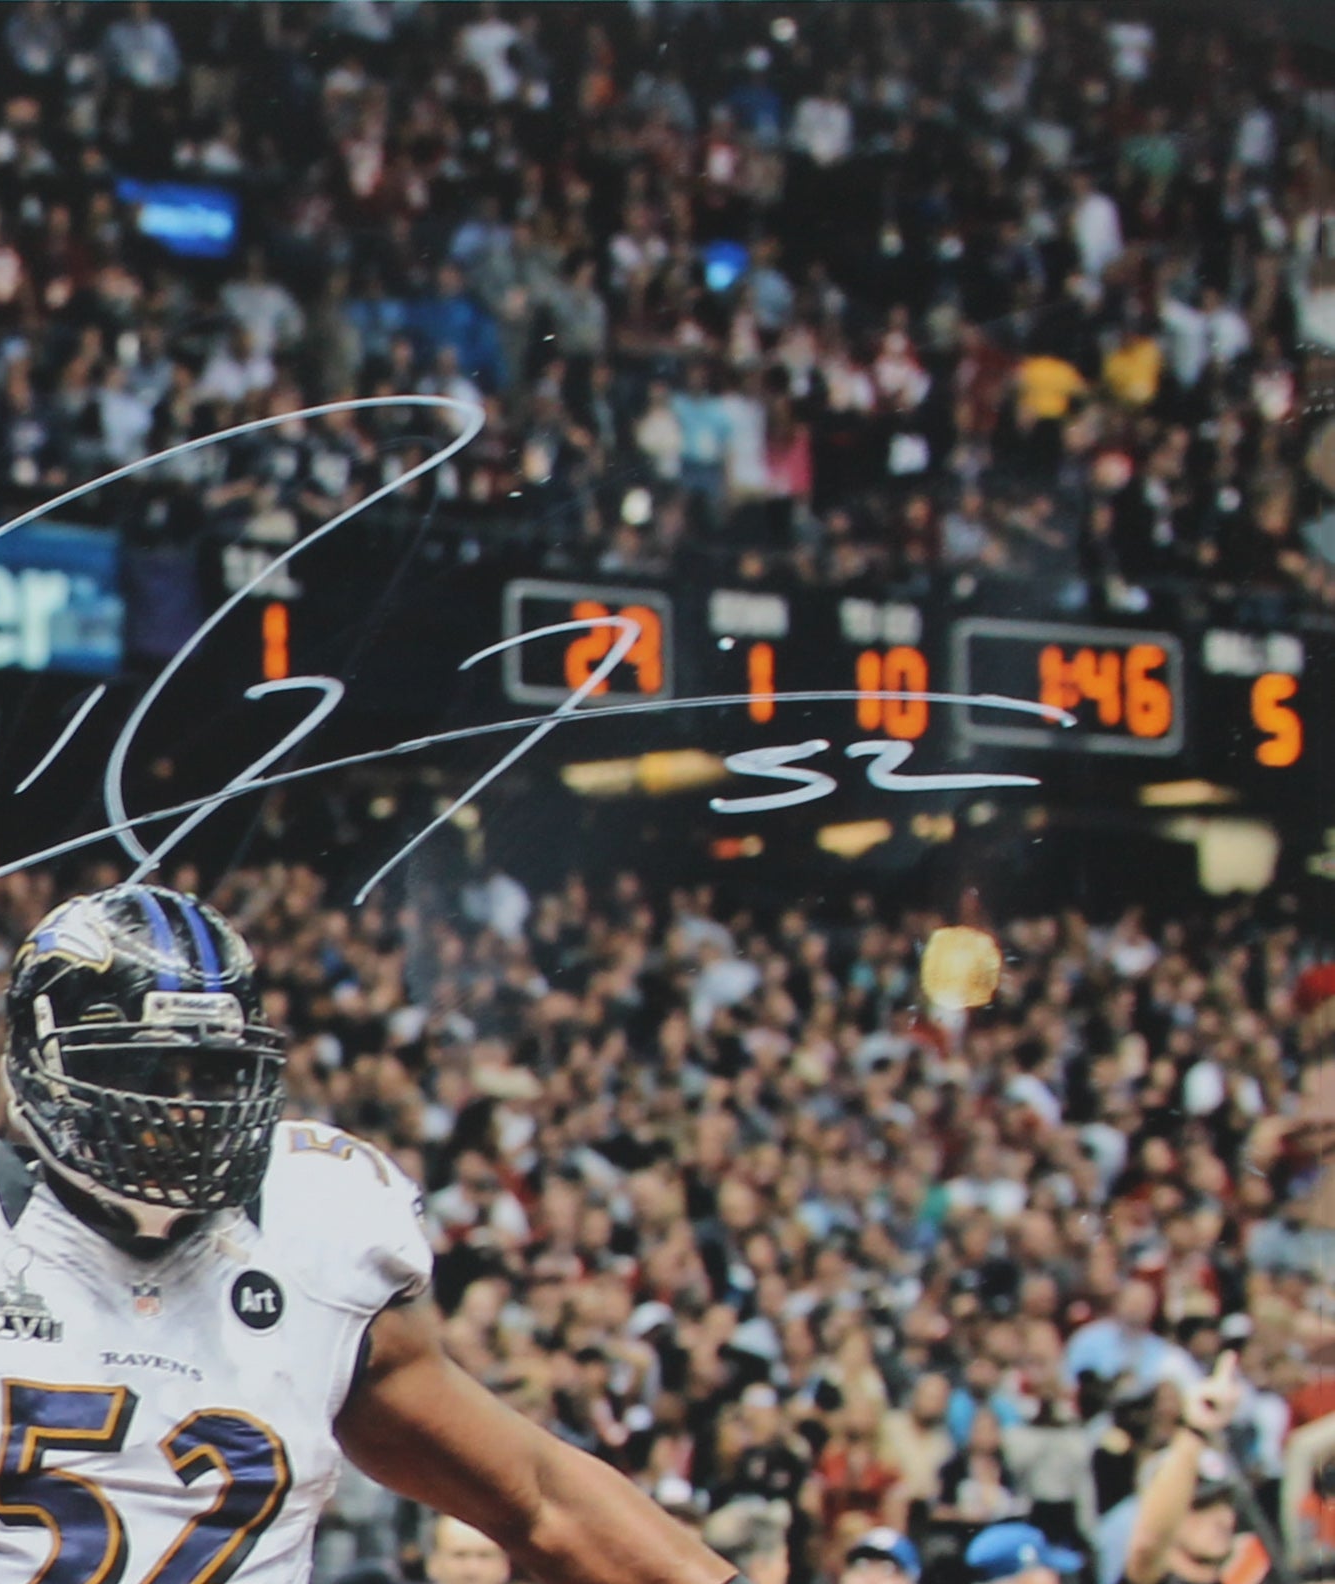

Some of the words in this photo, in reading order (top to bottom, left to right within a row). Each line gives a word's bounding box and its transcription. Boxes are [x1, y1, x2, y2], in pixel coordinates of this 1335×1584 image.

[263, 603, 289, 681] 1
[748, 642, 776, 724] 1
[856, 645, 929, 741] 10
[1251, 672, 1304, 768] 5
[239, 1287, 277, 1314] Art
[100, 1351, 203, 1382] RAVENS
